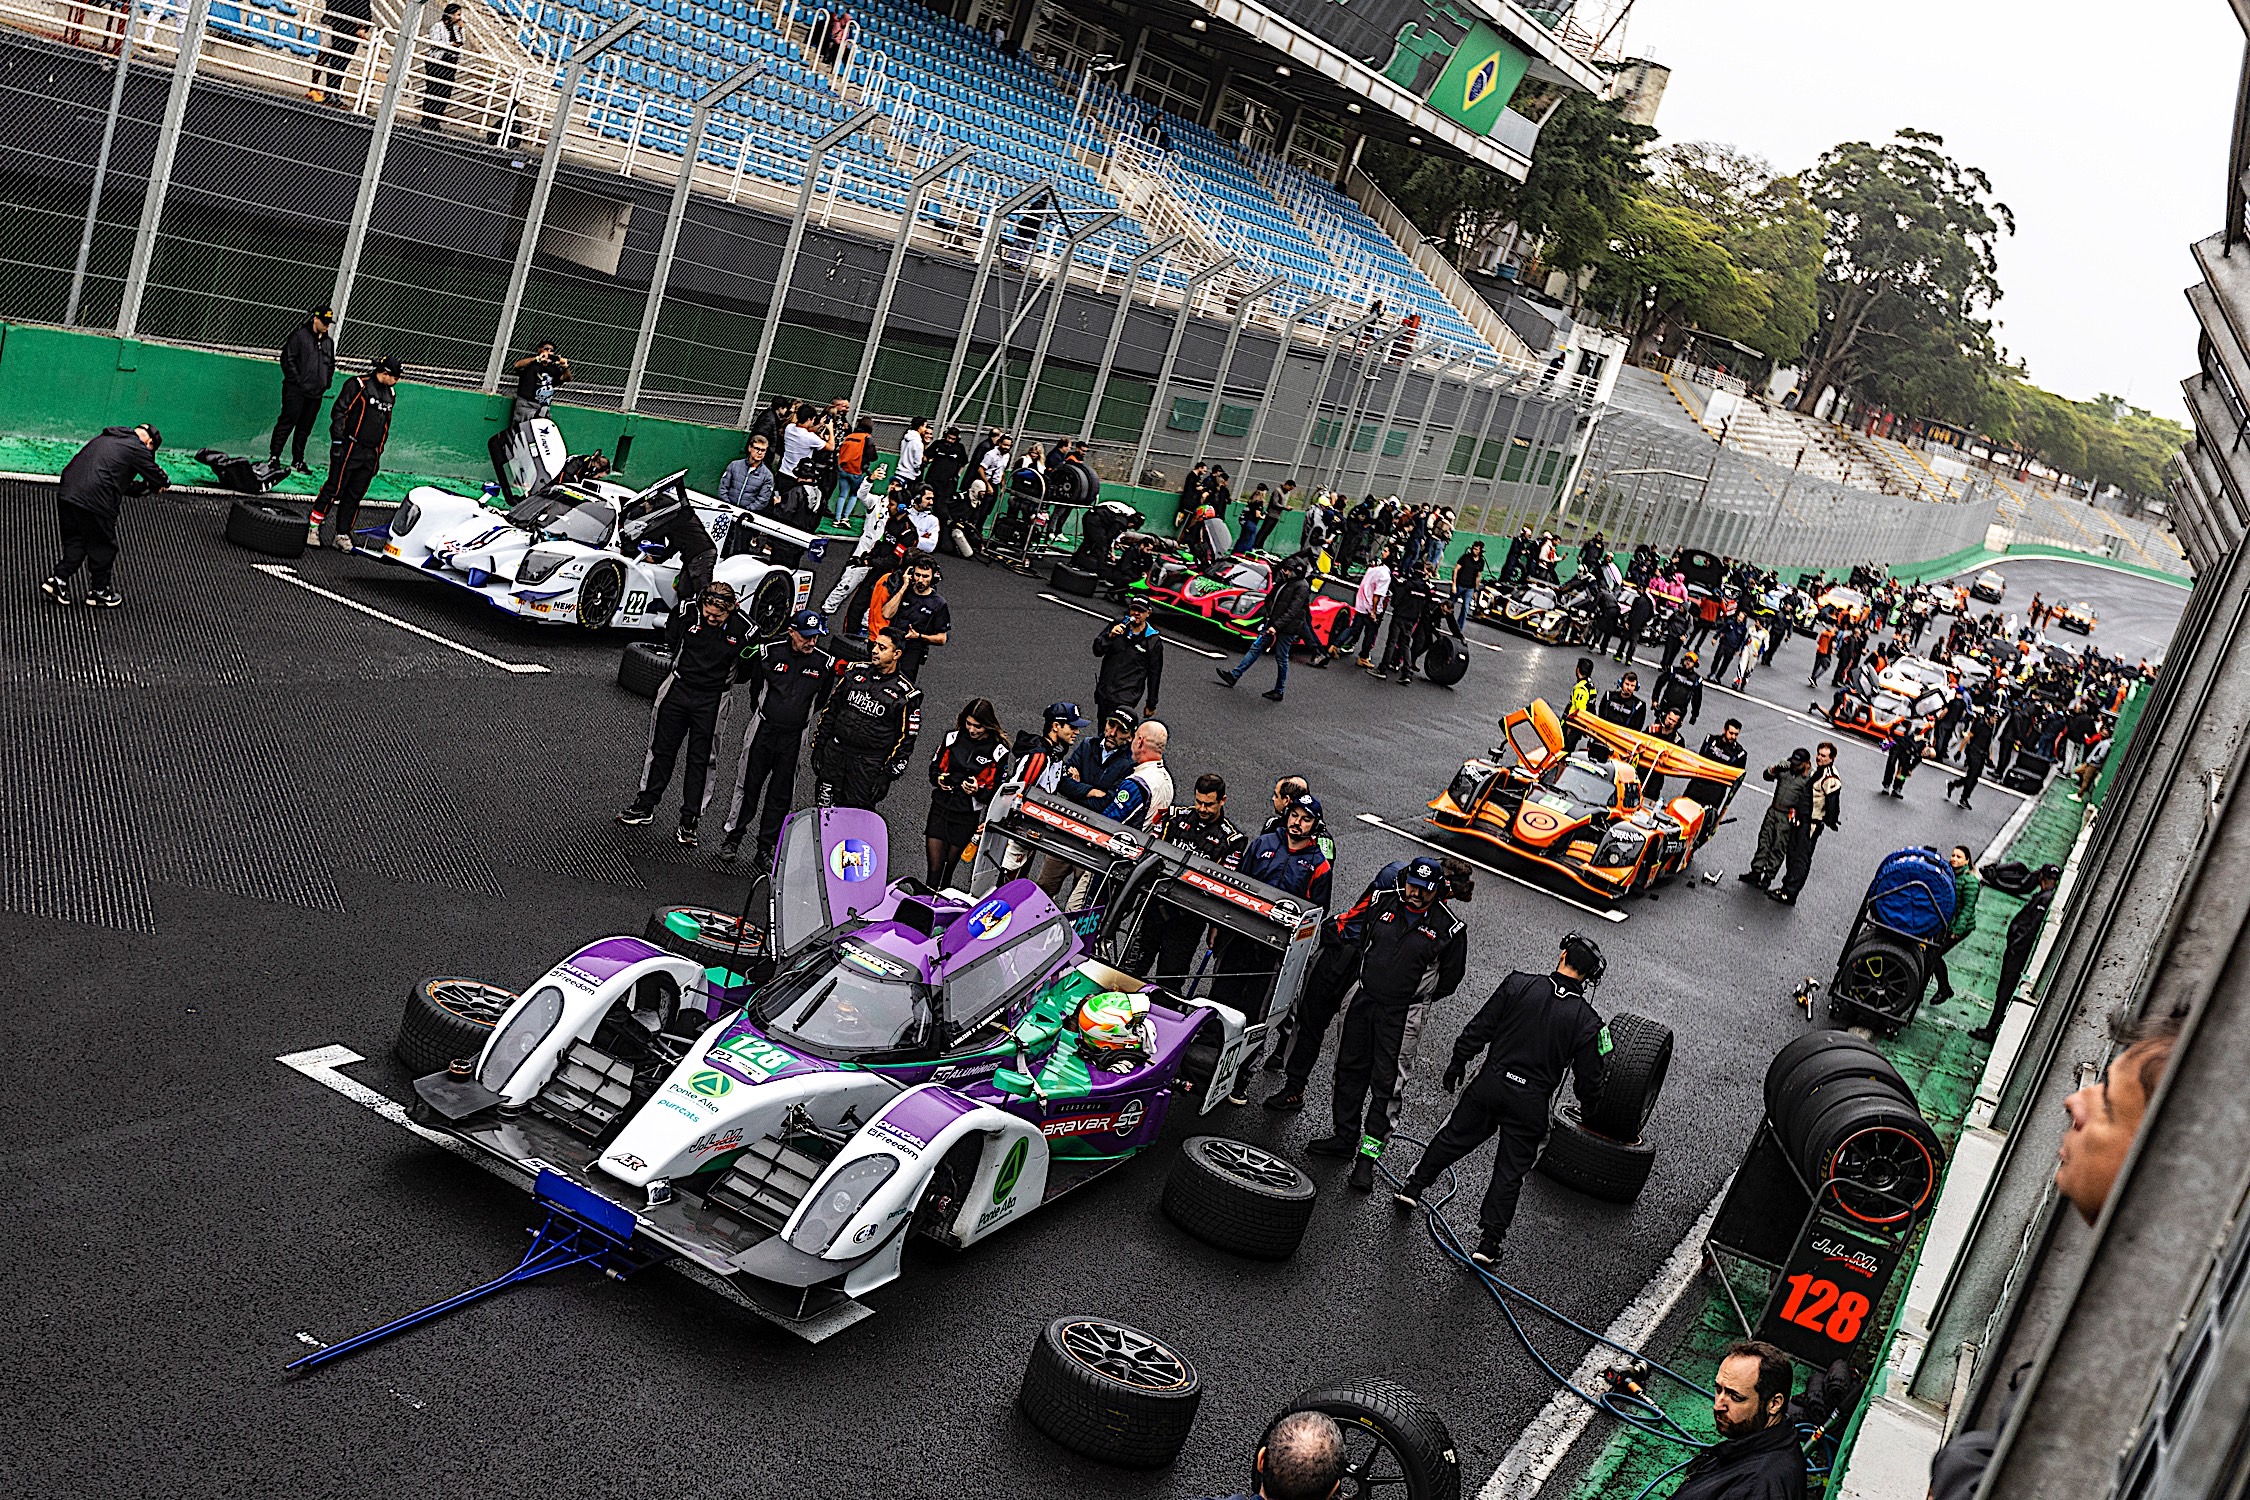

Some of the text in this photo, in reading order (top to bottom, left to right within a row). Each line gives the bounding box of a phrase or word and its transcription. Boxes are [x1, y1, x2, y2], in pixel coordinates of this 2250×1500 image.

[626, 592, 645, 613] 22
[1044, 800, 1089, 822] ACADEMIA
[861, 844, 871, 878] purrcats
[1206, 868, 1251, 890] ACADEMIA
[969, 900, 998, 925] purrcats
[558, 972, 596, 996] Freedom
[728, 1035, 792, 1070] 128
[657, 1099, 700, 1123] purrcats
[669, 1083, 698, 1100] Ponte
[700, 1097, 720, 1114] Alta
[1060, 1102, 1102, 1112] ACADEMIA
[875, 1120, 926, 1150] purrcats
[876, 1132, 919, 1161] Freedom
[977, 1205, 1000, 1227] Ponte
[1000, 1196, 1017, 1215] Alta
[1844, 1262, 1874, 1279] racing
[1779, 1272, 1870, 1344] 128
